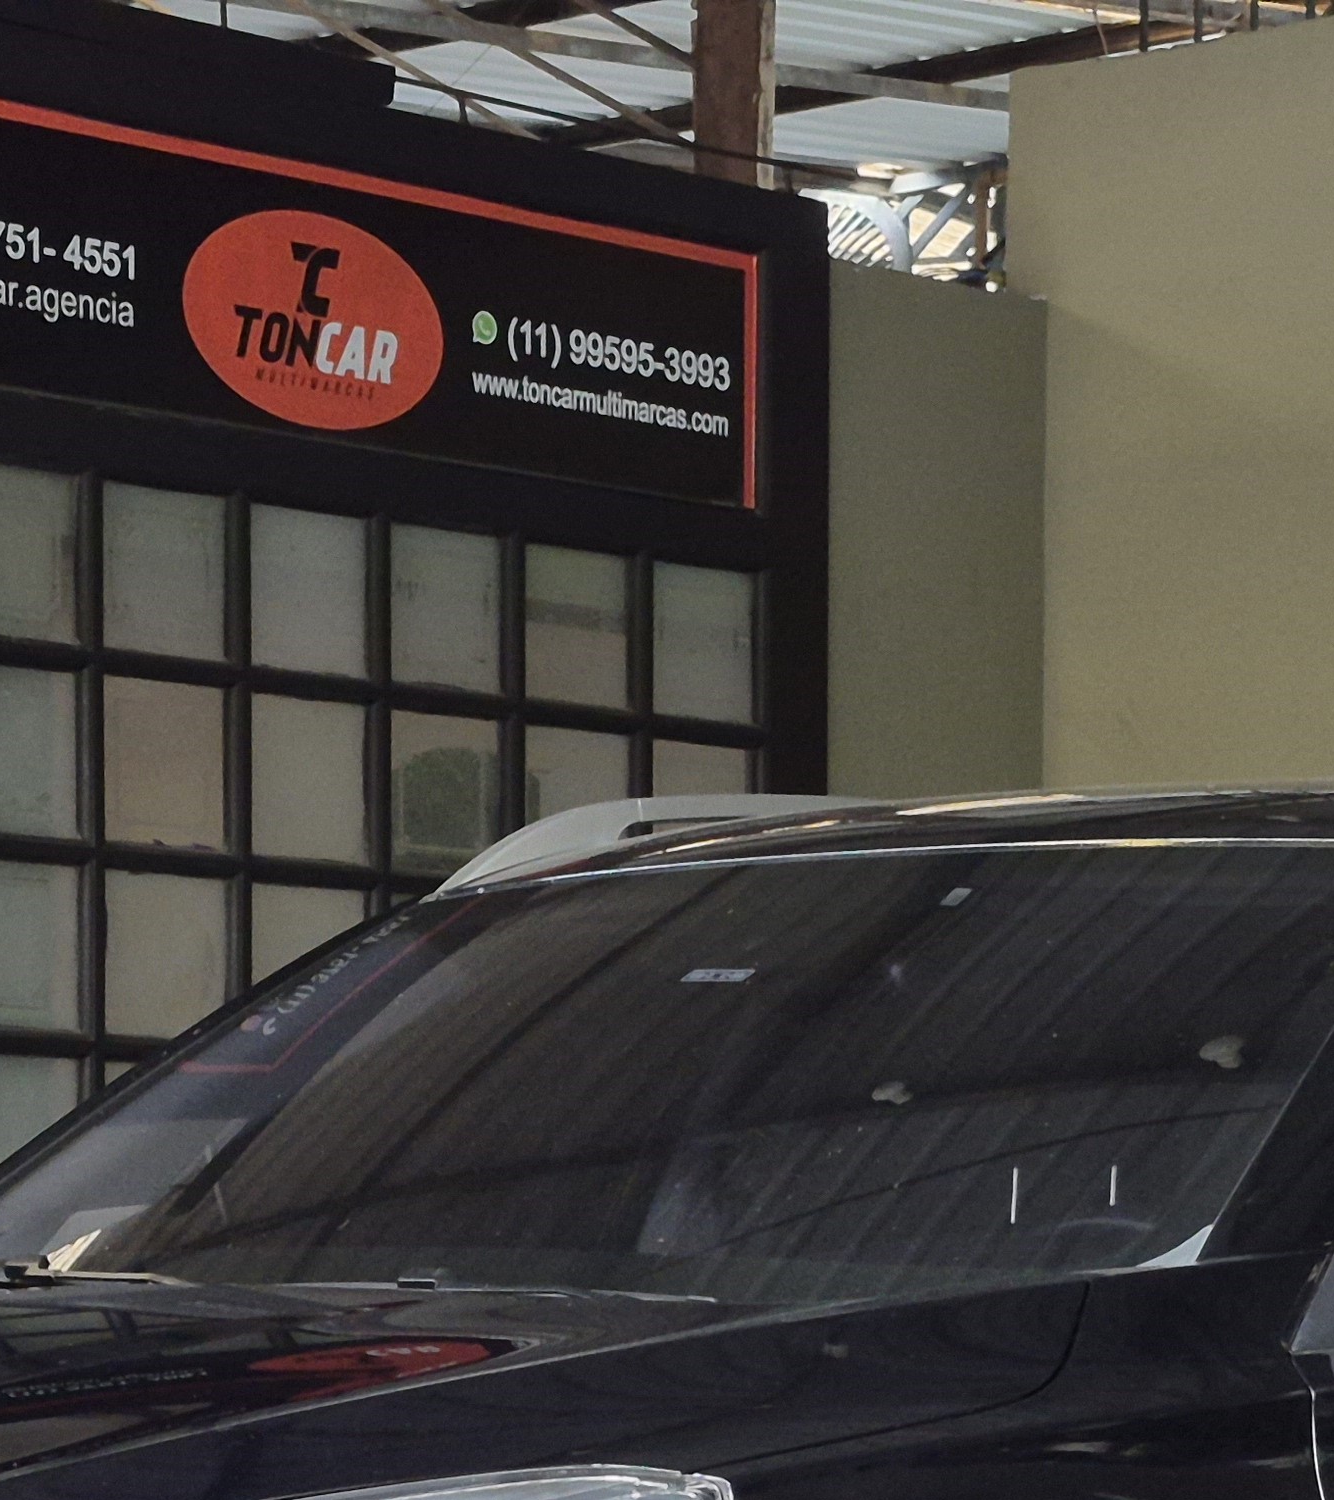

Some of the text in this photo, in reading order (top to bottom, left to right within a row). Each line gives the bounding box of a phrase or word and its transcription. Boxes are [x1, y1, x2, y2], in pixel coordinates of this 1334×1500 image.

[62, 233, 137, 281] 4551
[233, 303, 399, 386] TONCAR
[507, 316, 731, 392] (11) 99595-3993
[254, 366, 376, 400] MULTIMARCAS
[471, 371, 729, 438] www.toncarmultimarcas.com
